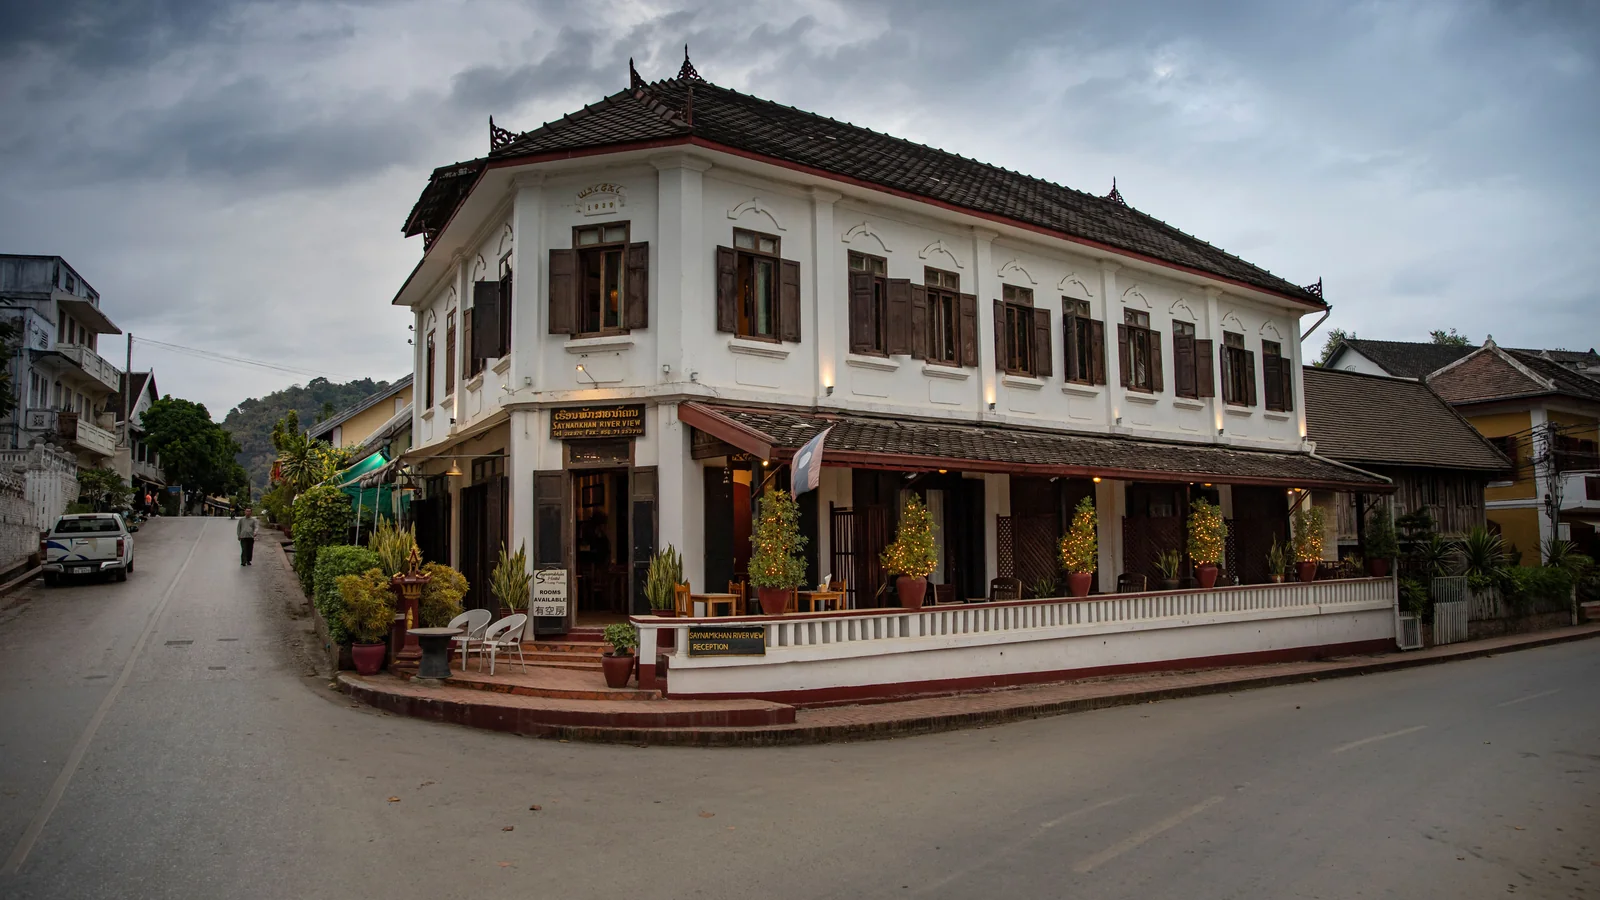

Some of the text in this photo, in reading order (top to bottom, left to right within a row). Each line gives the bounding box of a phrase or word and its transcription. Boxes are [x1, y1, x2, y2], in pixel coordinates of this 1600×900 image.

[599, 420, 621, 428] RIVER
[622, 419, 641, 427] VIEW
[535, 605, 565, 616] 有空房
[693, 643, 729, 651] RECEPTION
